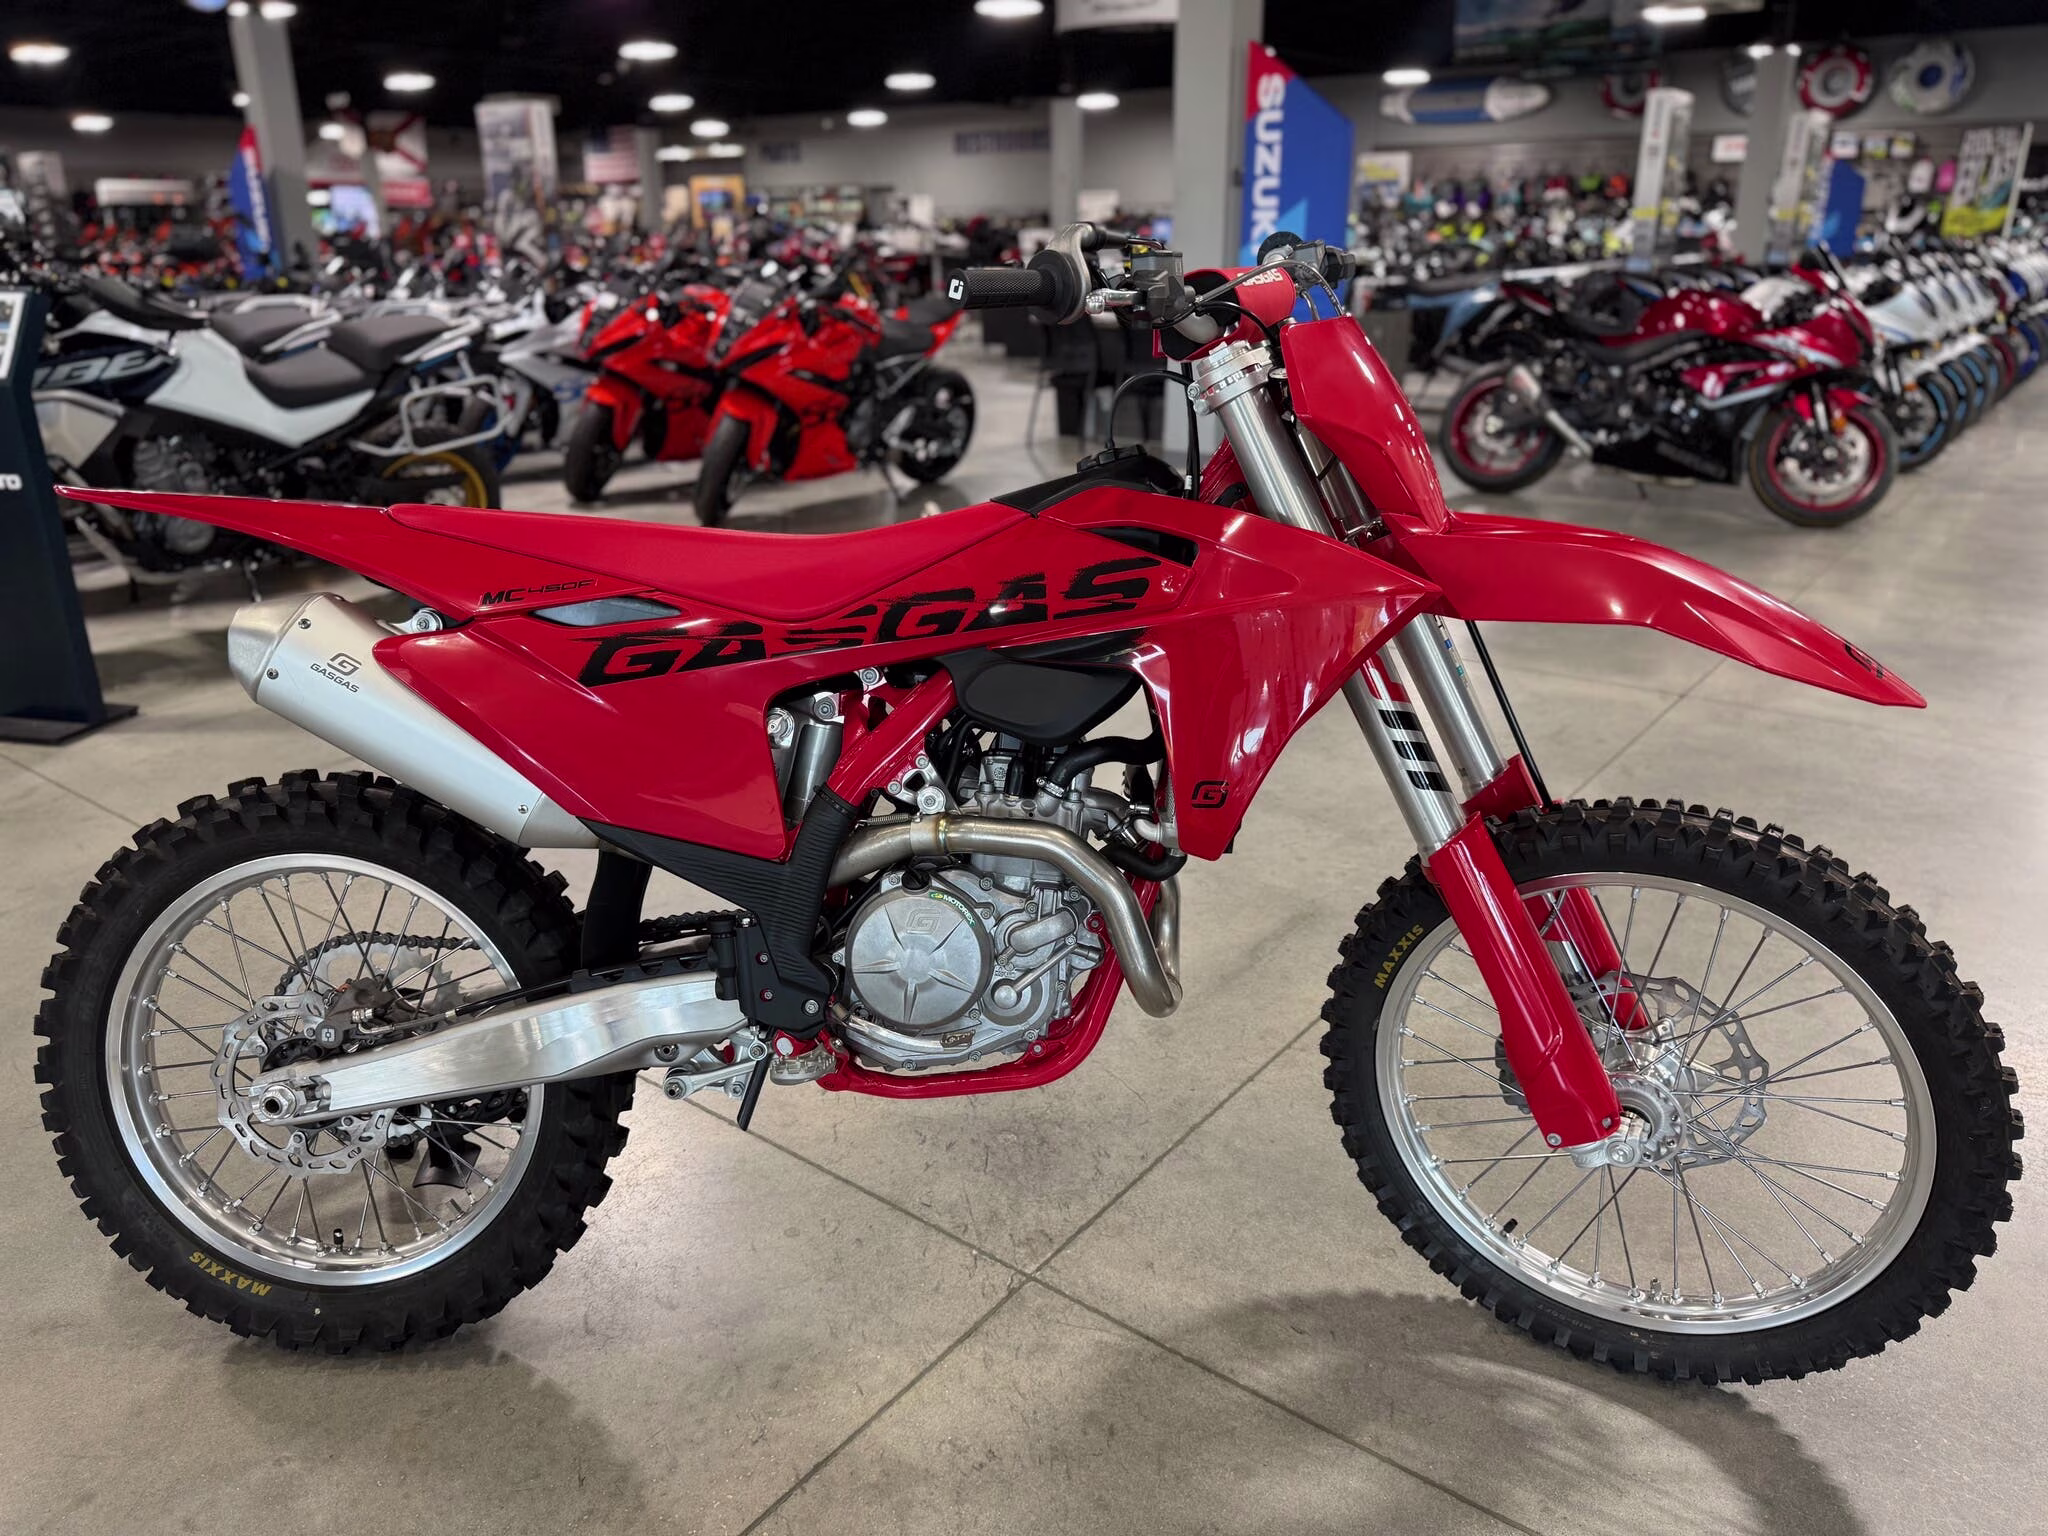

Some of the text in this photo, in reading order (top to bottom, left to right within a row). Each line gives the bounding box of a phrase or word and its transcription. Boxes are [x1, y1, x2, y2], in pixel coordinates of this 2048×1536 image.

[32, 350, 172, 391] IBE
[572, 557, 1162, 687] GASGAS
[310, 663, 360, 693] GASGAS
[943, 893, 976, 926] MOTOREX
[1374, 924, 1424, 989] MAXXIS
[188, 1251, 273, 1297] MAXXIS
